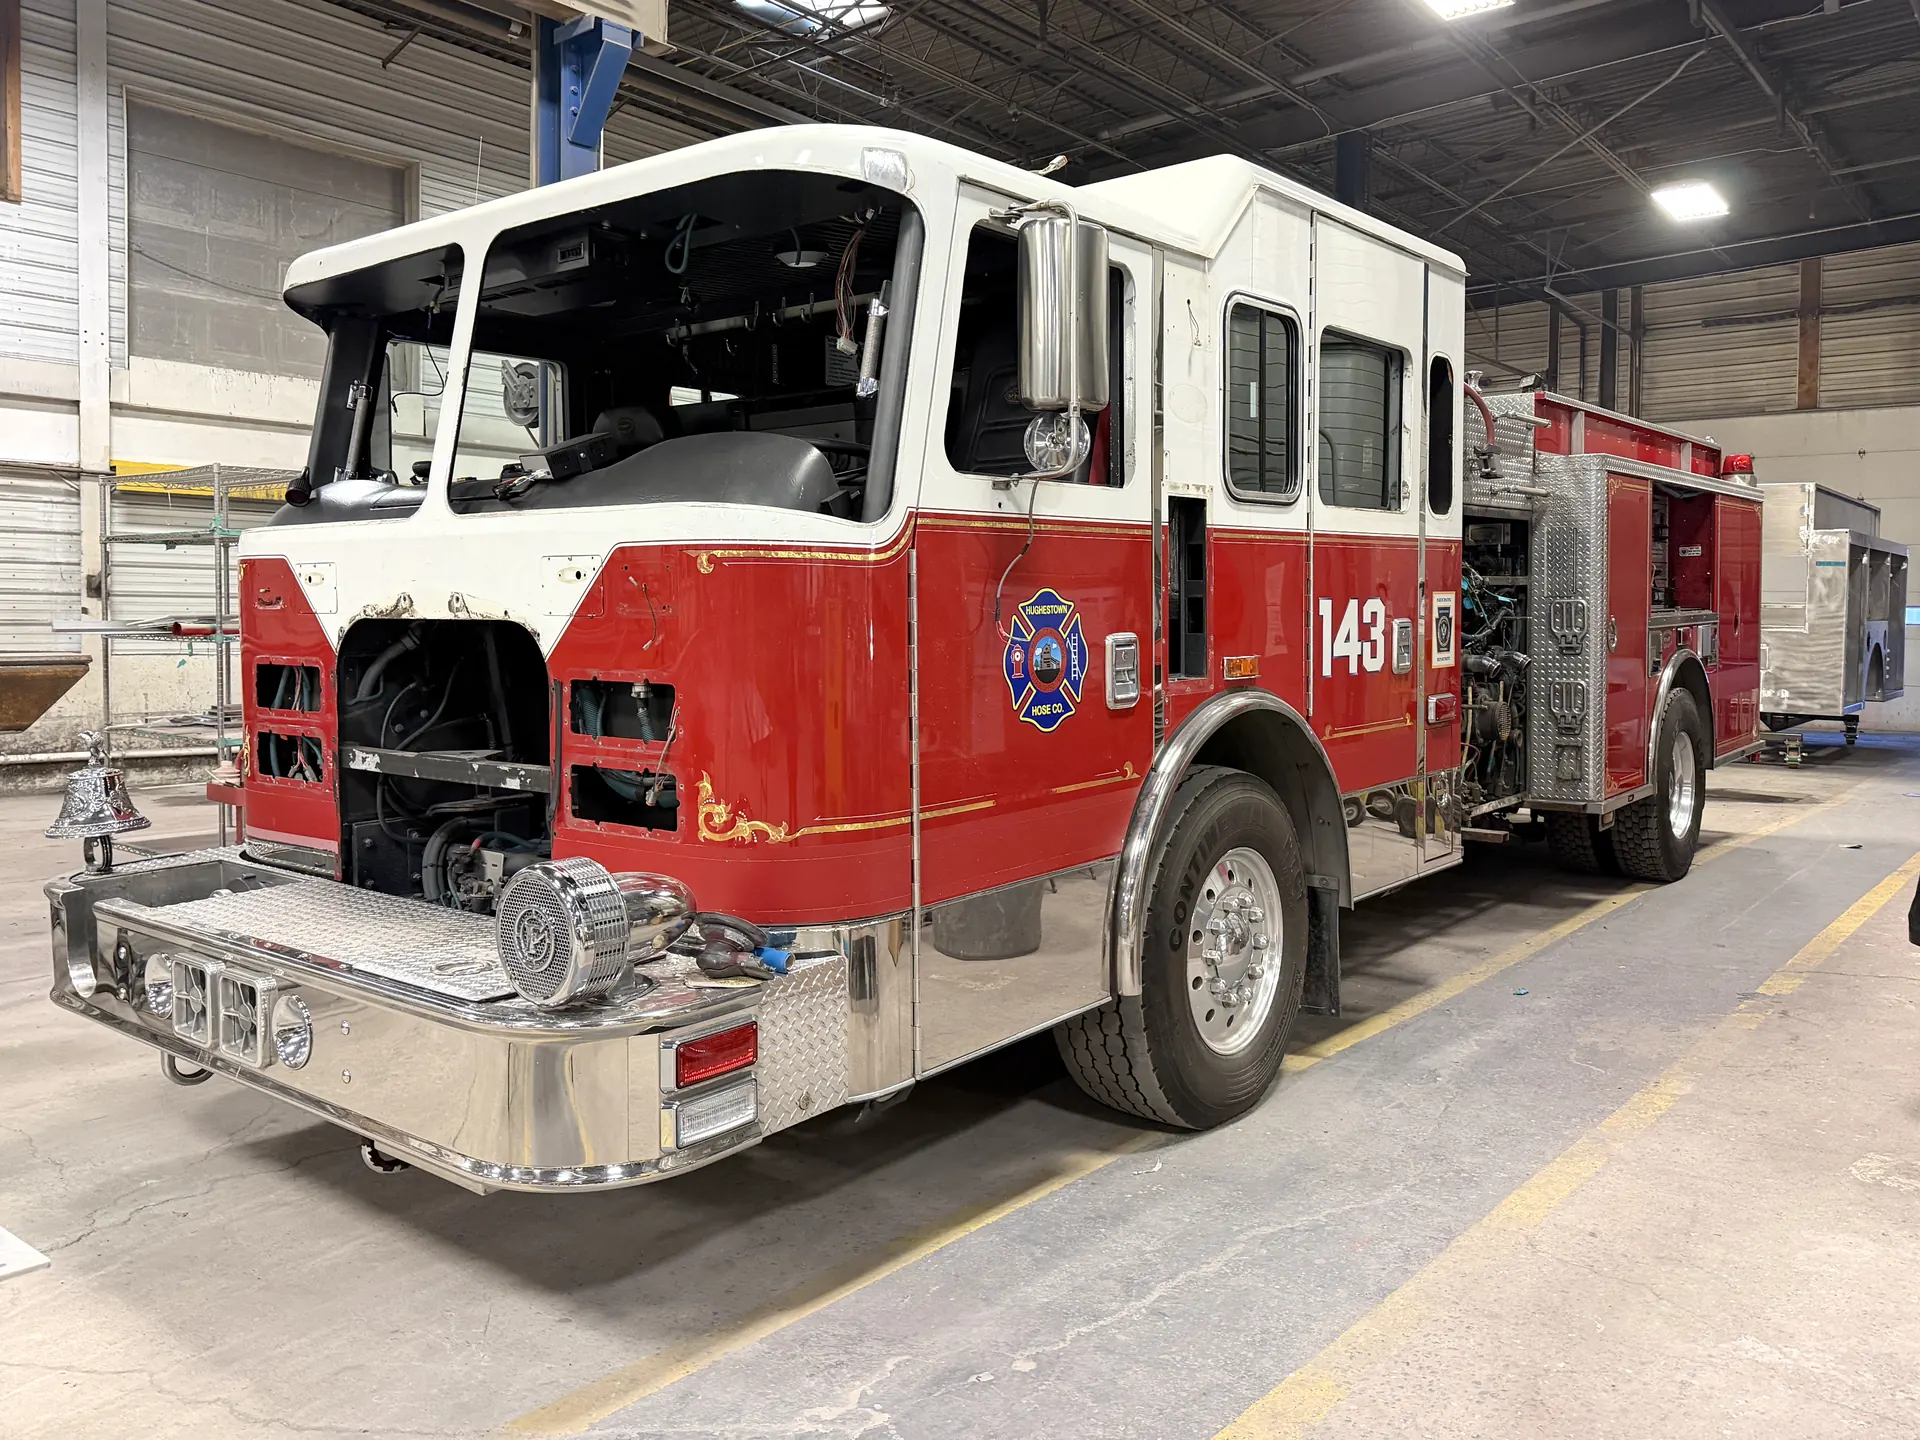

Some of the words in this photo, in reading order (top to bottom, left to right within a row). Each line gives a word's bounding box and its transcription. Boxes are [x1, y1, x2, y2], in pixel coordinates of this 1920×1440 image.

[1026, 605, 1067, 615] HUGHESTOWN
[1318, 597, 1386, 678] 143
[1032, 704, 1051, 716] HOSE
[1052, 703, 1064, 713] CO.
